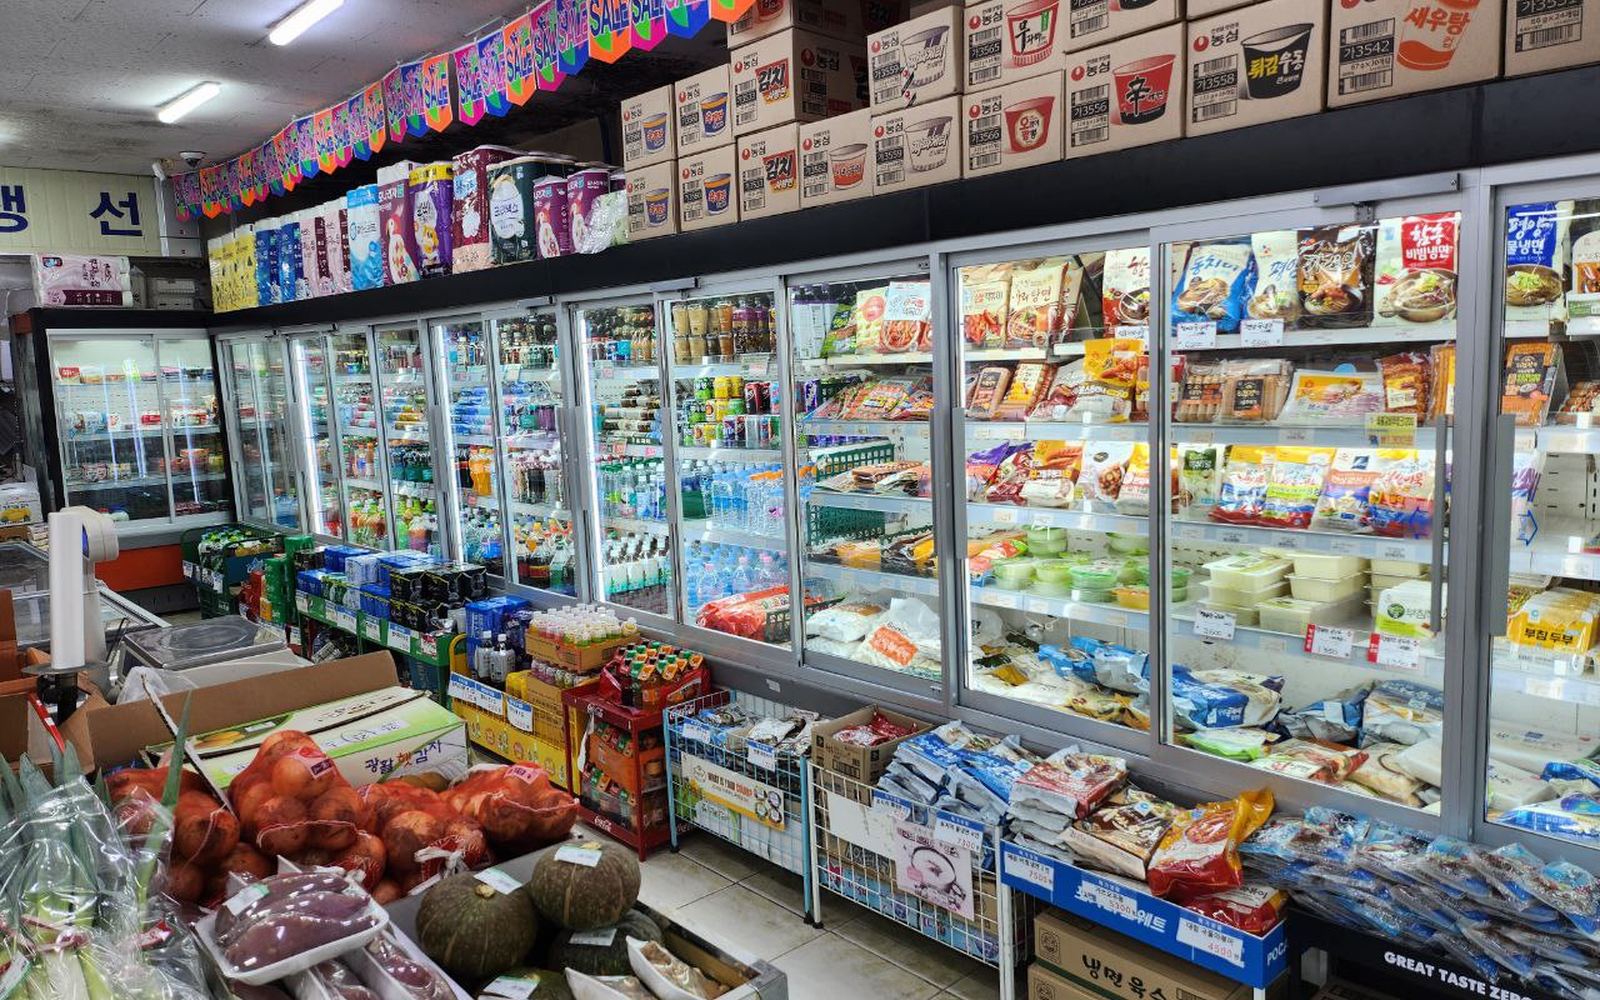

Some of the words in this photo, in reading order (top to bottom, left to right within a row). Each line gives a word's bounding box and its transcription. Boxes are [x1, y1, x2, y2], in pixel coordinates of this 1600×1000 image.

[590, 0, 631, 37] SALE
[982, 10, 1003, 26] 농심
[1404, 7, 1471, 36] 새우탕
[1211, 29, 1239, 47] 농심
[759, 63, 786, 91] 김치
[1086, 61, 1111, 77] 농심
[1248, 50, 1304, 79] 튀김우동
[981, 99, 1002, 115] 농심
[1126, 75, 1151, 117] 辛
[766, 155, 793, 181] 김치
[89, 192, 143, 236] 선
[1189, 255, 1240, 276] 동치미
[1406, 246, 1450, 262] 비빔냉면
[1524, 627, 1549, 642] 부침
[1549, 631, 1574, 646] 두부
[1082, 953, 1124, 987] 냉면
[1384, 951, 1435, 978] GREAT
[1438, 967, 1488, 995] TASTE
